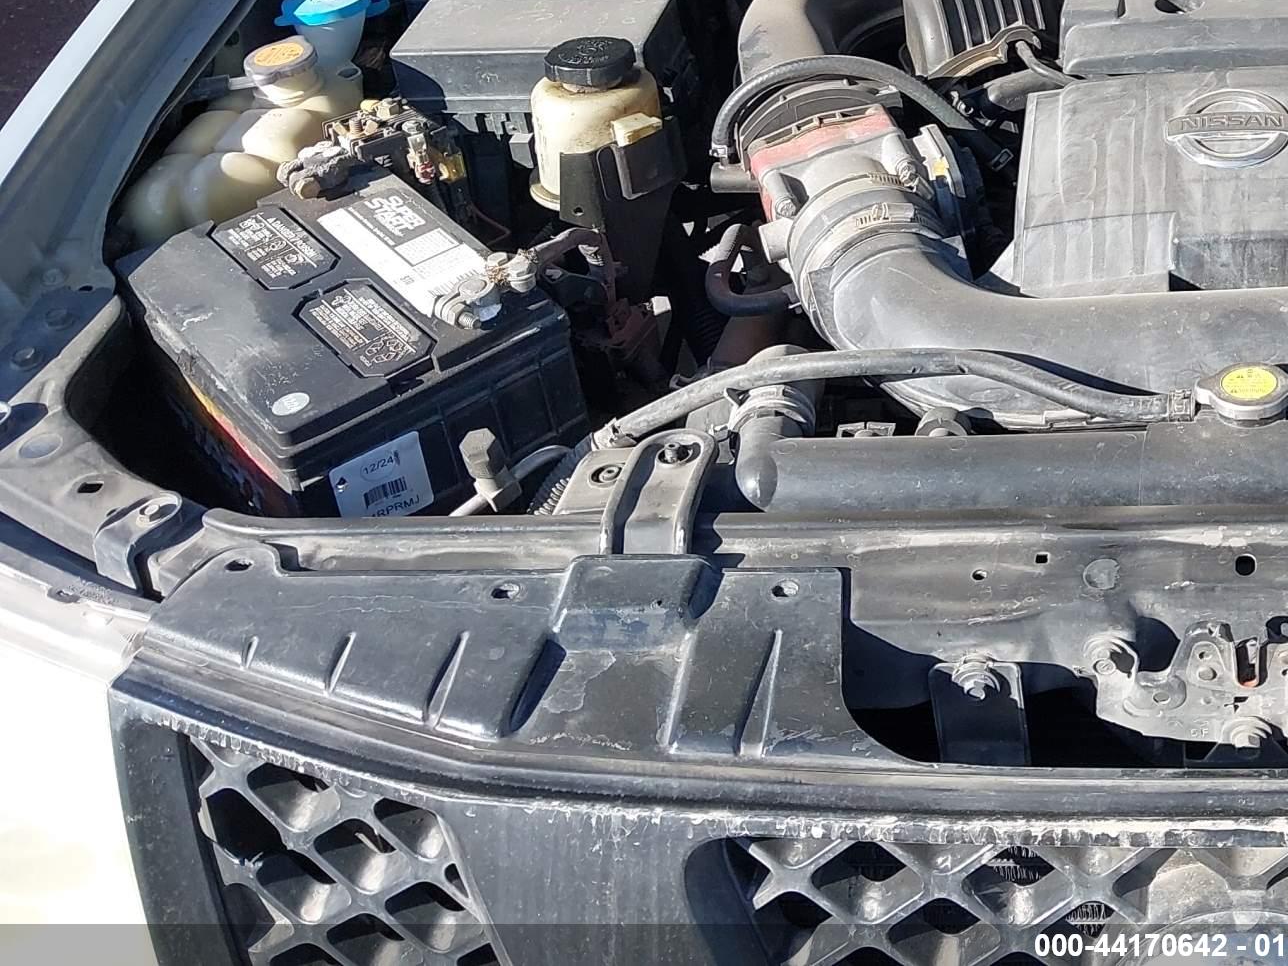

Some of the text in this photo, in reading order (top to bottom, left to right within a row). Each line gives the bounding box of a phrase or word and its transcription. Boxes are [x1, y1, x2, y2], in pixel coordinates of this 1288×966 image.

[1181, 114, 1285, 131] NISSAN
[388, 196, 426, 228] SUPER
[362, 456, 394, 474] 12/24
[372, 494, 419, 517] RPRMJ
